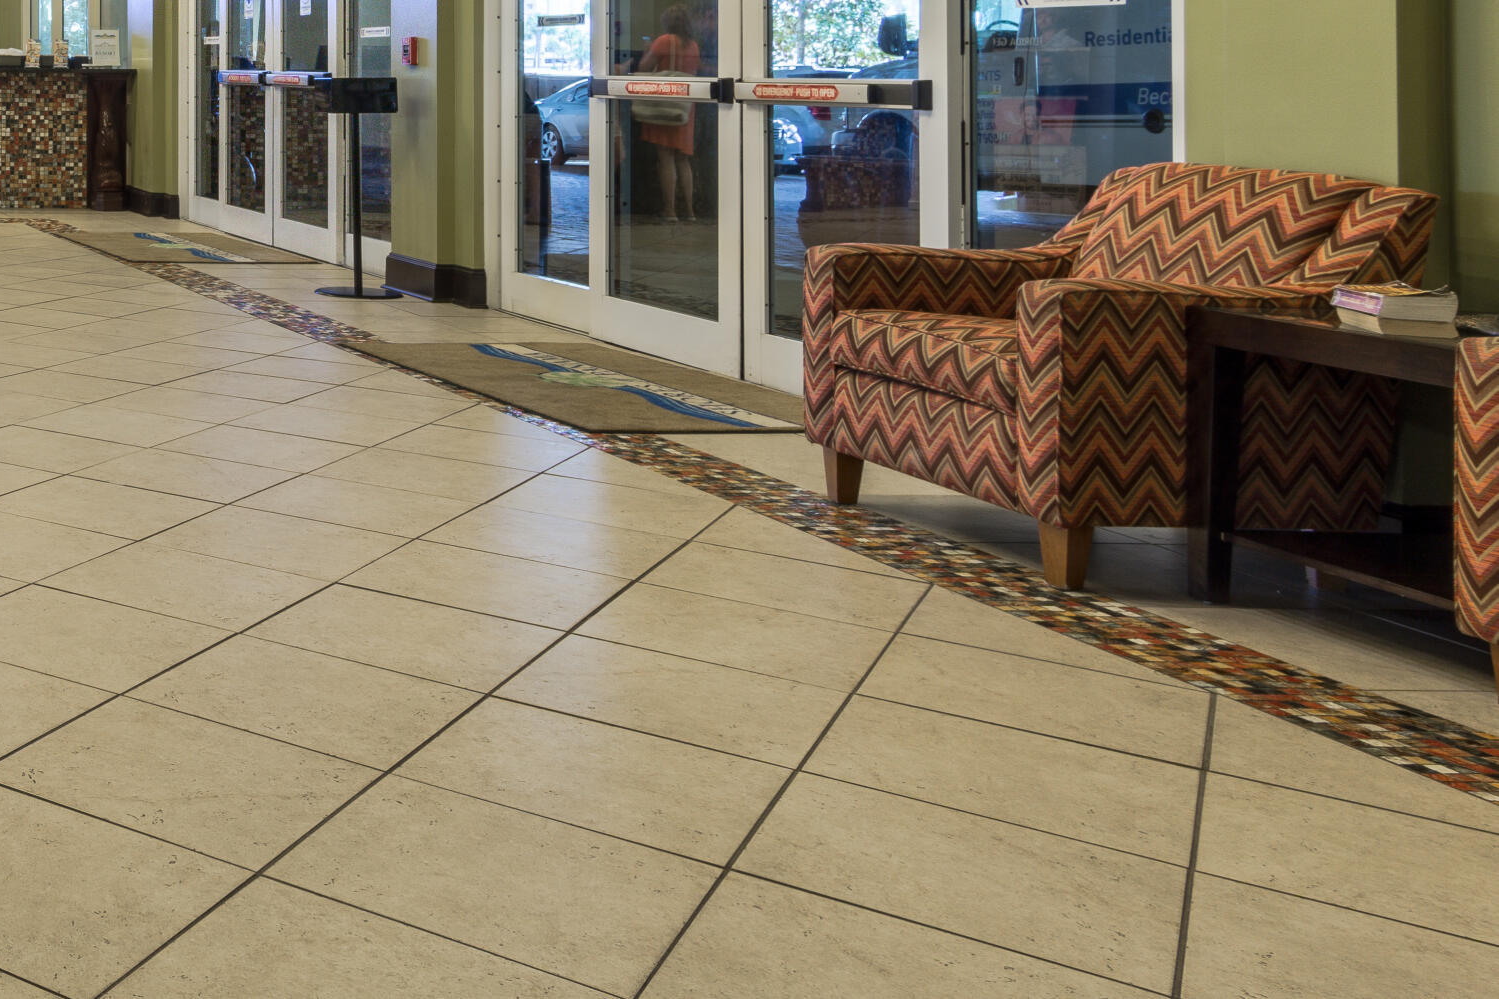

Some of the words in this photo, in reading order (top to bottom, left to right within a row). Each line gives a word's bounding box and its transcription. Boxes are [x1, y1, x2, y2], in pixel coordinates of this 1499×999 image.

[763, 88, 793, 96] EMERGENCY
[796, 88, 810, 96] PUSH
[820, 88, 834, 97] OPEN
